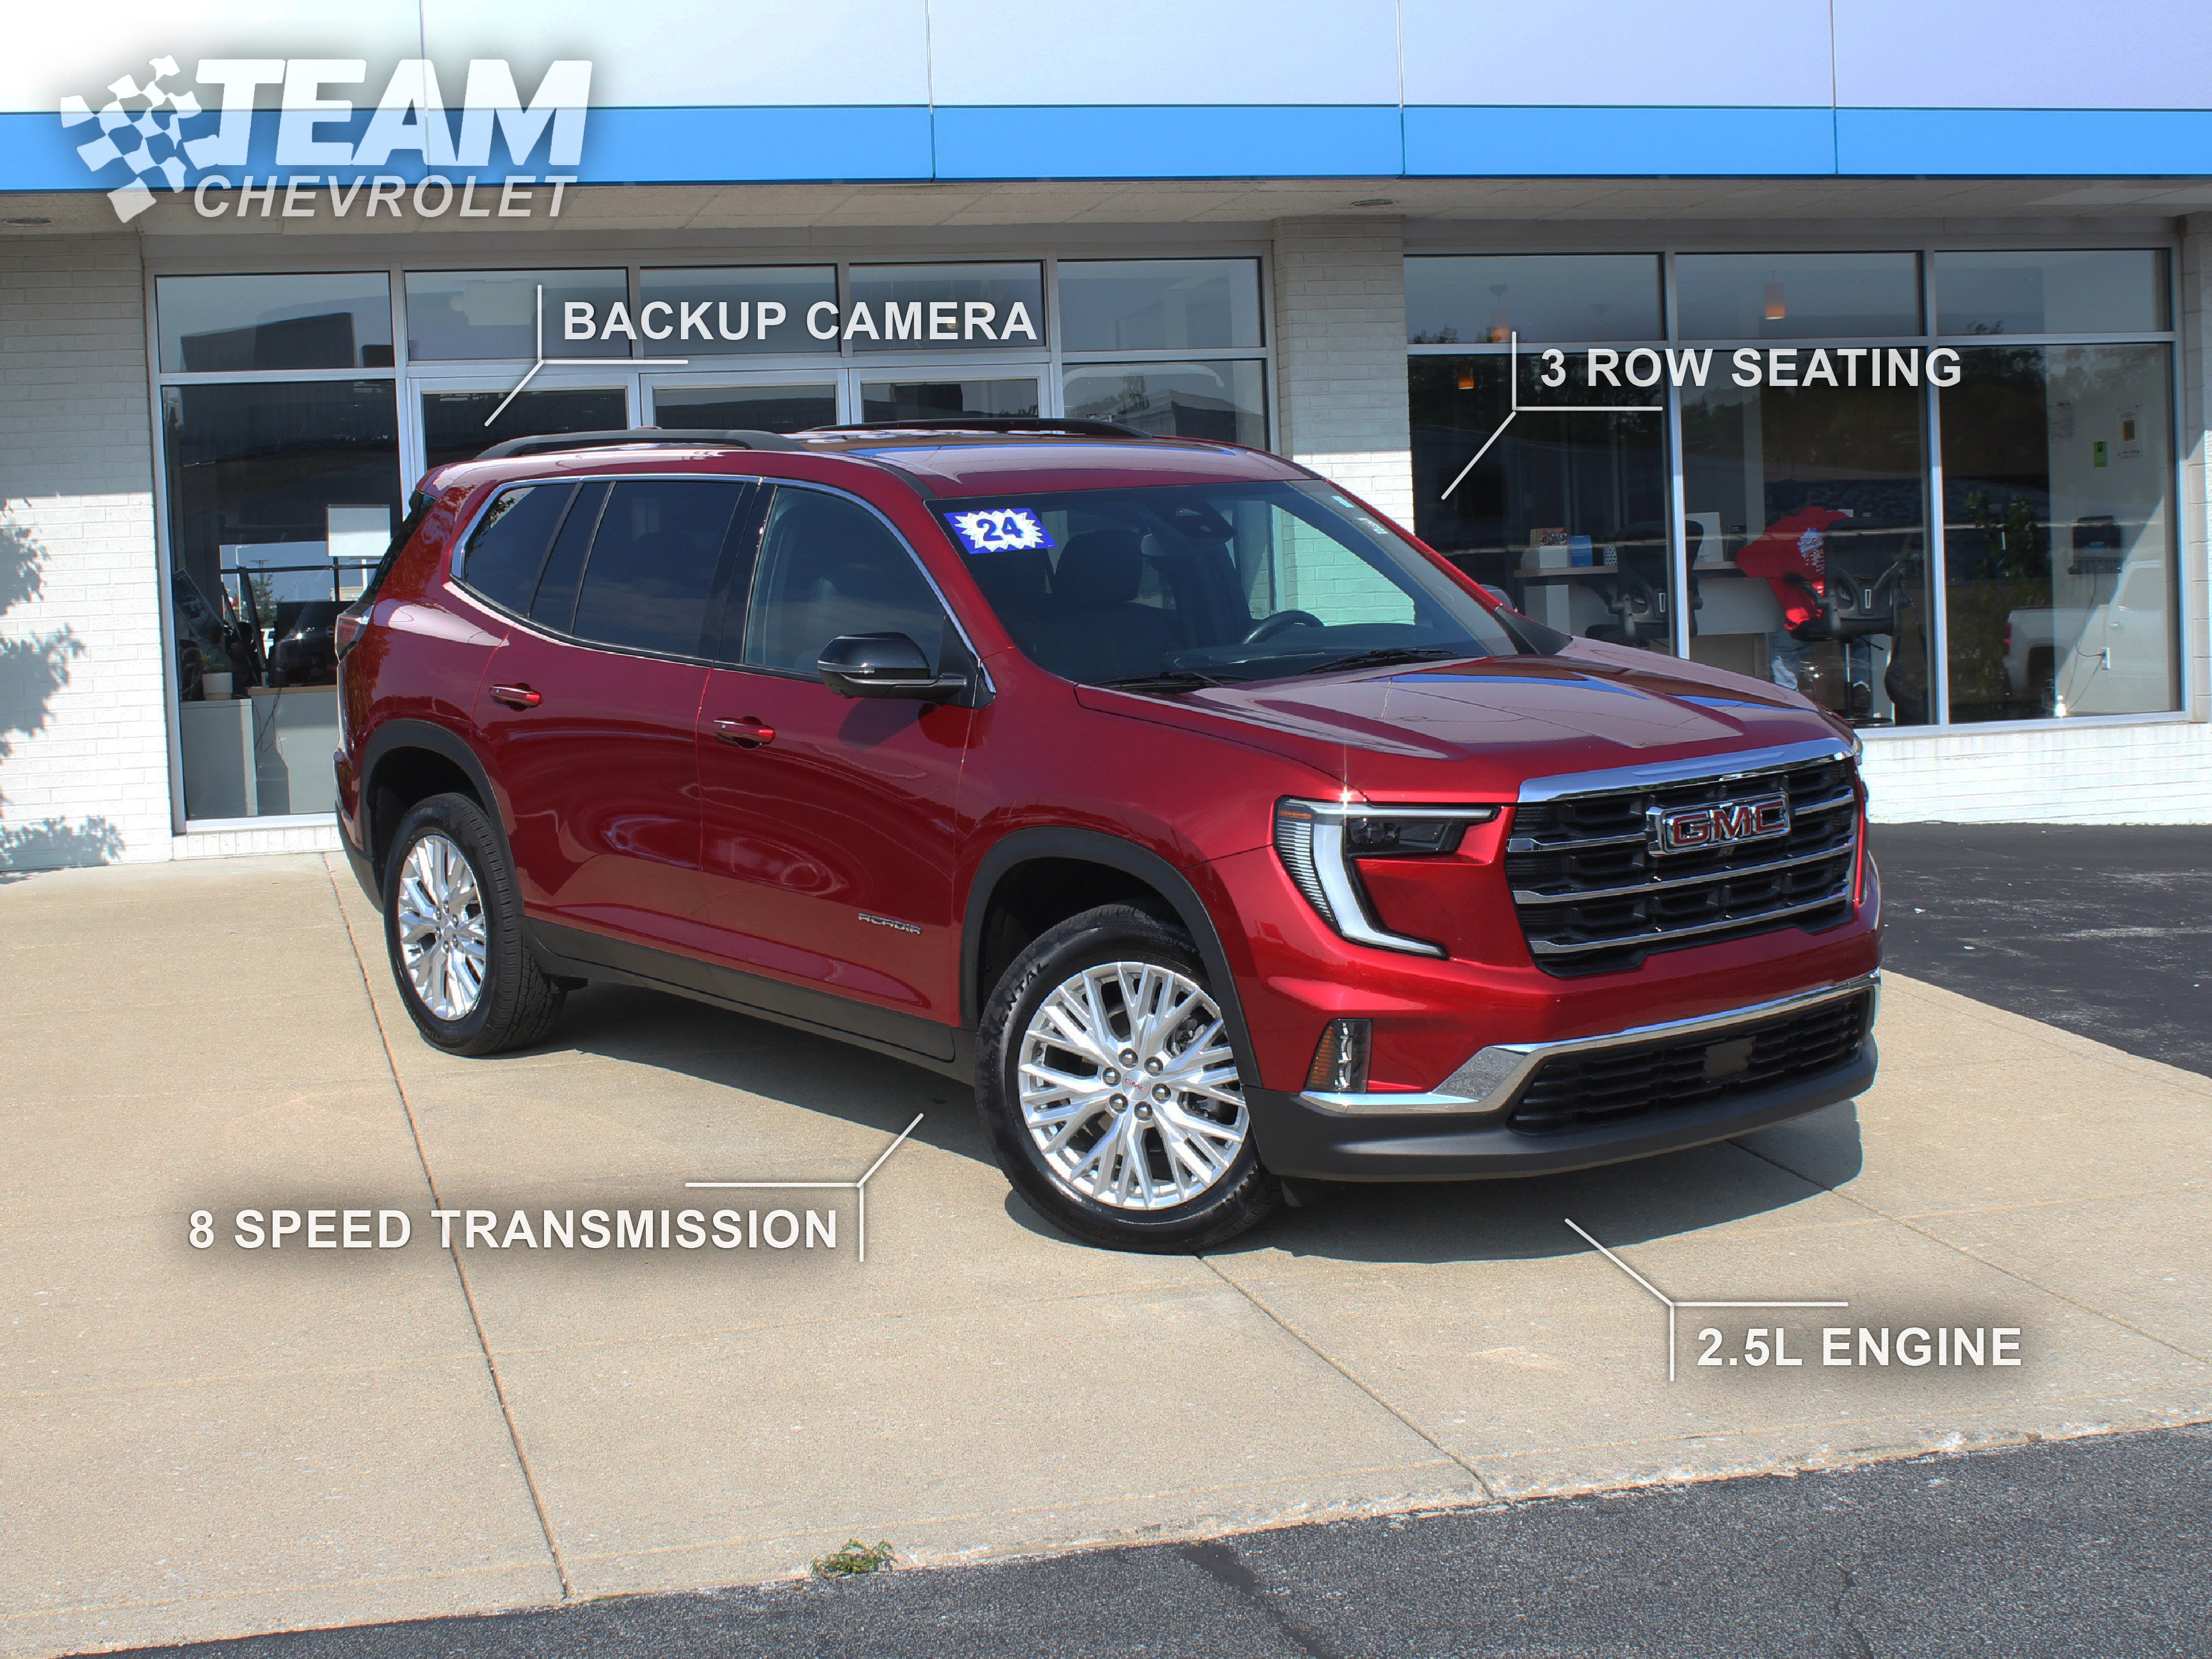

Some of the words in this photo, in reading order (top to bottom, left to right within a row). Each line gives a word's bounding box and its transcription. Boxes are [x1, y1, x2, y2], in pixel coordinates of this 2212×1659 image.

[976, 517, 1025, 541] 24
[1666, 798, 1788, 845] GMC
[858, 913, 922, 934] ACADIA
[1125, 1078, 1148, 1094] GMC
